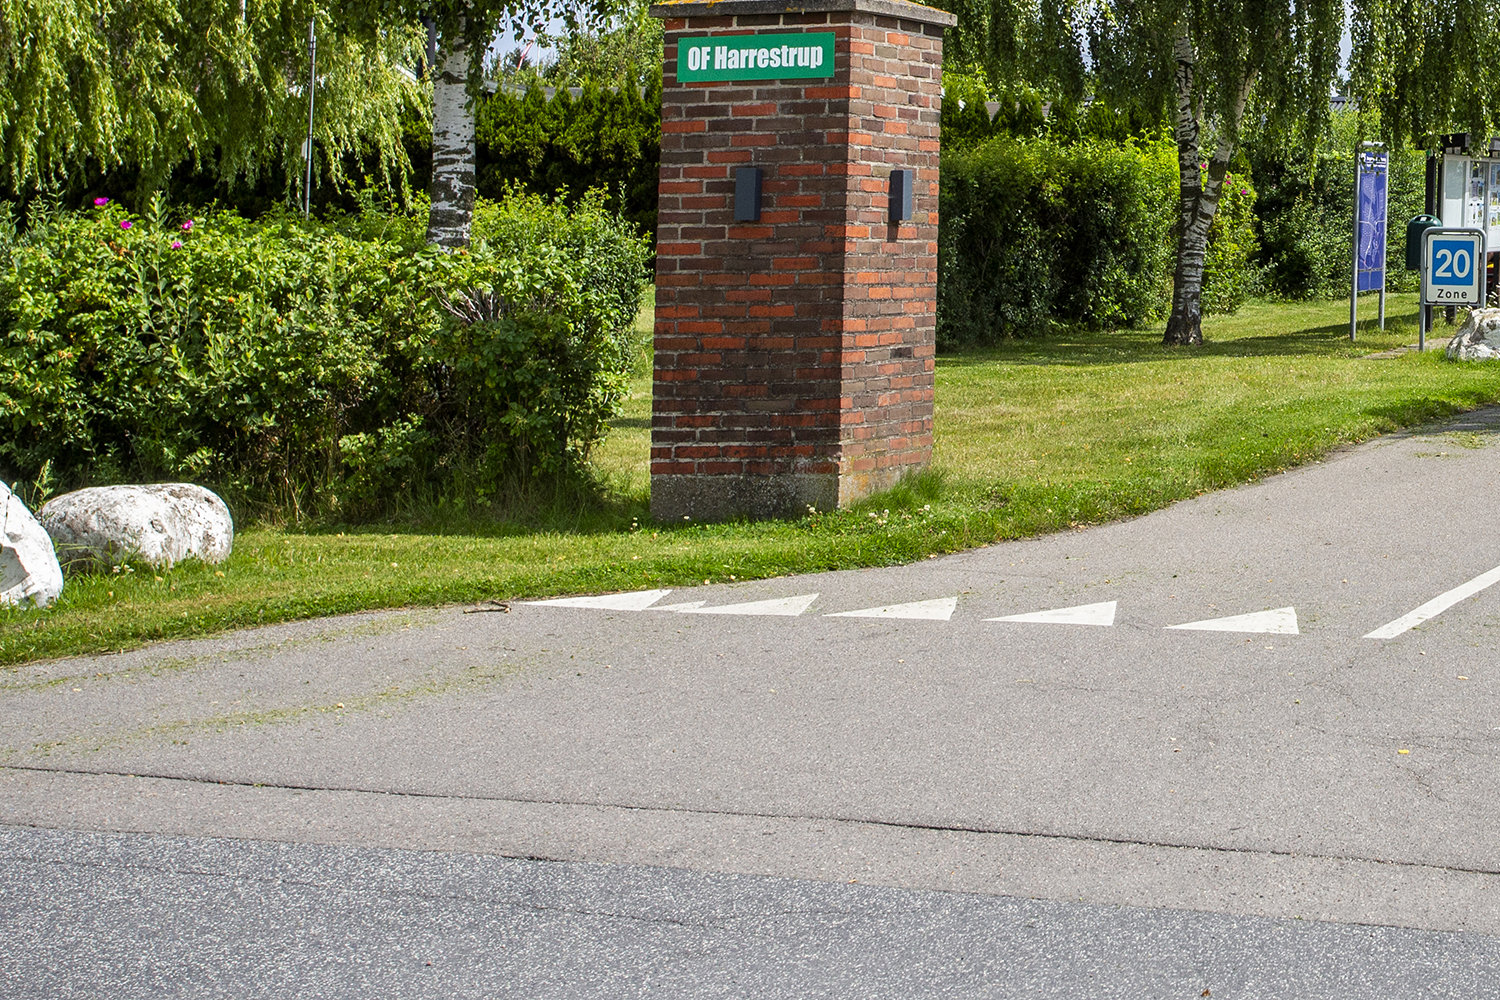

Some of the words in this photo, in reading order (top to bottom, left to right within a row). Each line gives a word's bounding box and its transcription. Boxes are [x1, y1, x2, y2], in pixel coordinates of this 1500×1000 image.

[687, 46, 711, 71] OF
[714, 45, 823, 70] Harrestrup
[1435, 249, 1470, 278] 20
[1437, 289, 1467, 299] Zone
